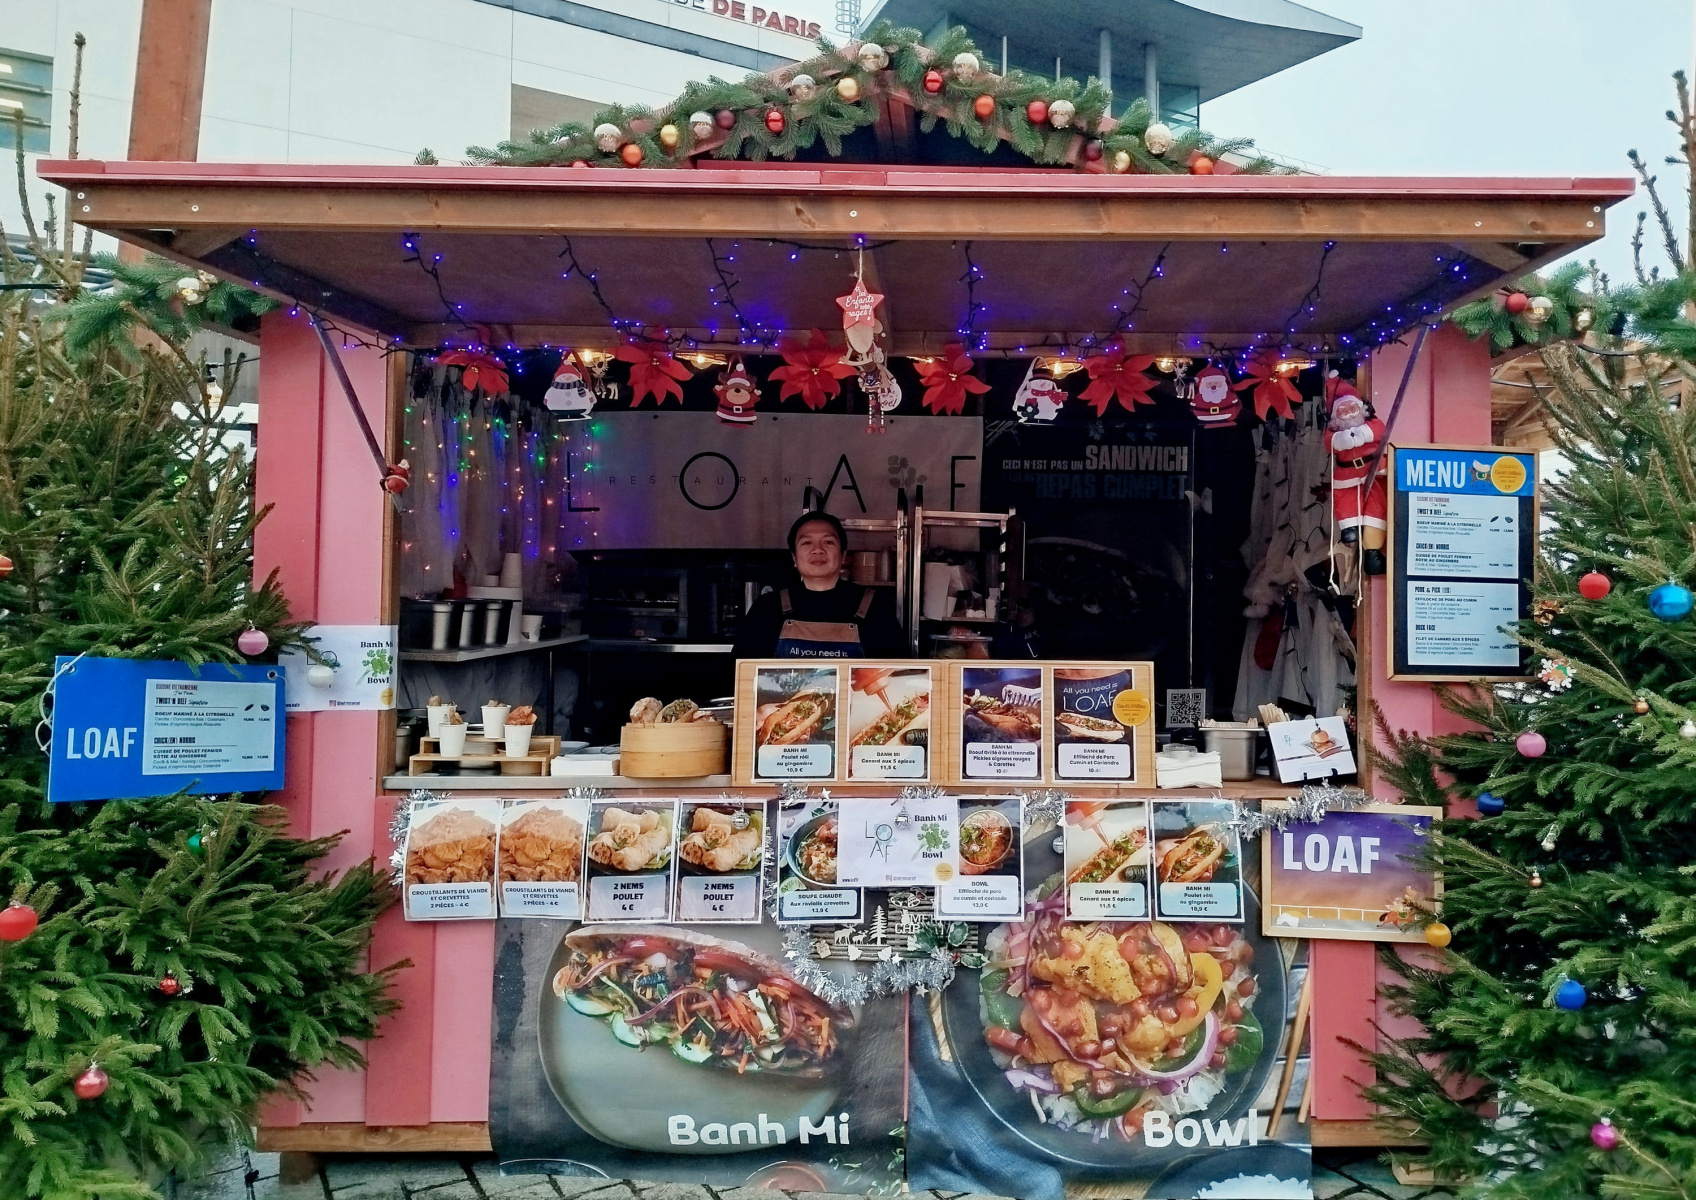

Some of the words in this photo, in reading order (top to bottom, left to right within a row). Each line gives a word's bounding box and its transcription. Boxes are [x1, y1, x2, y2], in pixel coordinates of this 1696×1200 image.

[713, 0, 745, 20] DE
[752, 6, 822, 39] PARIS
[1002, 459, 1021, 470] CECI
[1023, 460, 1047, 470] N'EST
[1051, 460, 1068, 471] PAS
[1071, 461, 1083, 471] UN
[1086, 444, 1188, 472] SANDWICH
[1036, 472, 1096, 499] REPAS
[1103, 474, 1188, 500] COMPLET
[1406, 459, 1466, 489] MENU
[385, 640, 393, 648] Mi
[819, 650, 841, 658] need
[1064, 690, 1117, 712] LOAF
[1075, 687, 1090, 695] you
[1092, 683, 1111, 692] need
[67, 727, 137, 760] LOAF
[914, 814, 937, 822] Banh
[938, 814, 948, 822] Mi
[1283, 832, 1381, 874] LOAF
[435, 901, 454, 909] PIÈCES
[667, 1114, 785, 1146] Banh
[799, 1112, 851, 1146] Mi
[1143, 1108, 1259, 1148] Bowl
